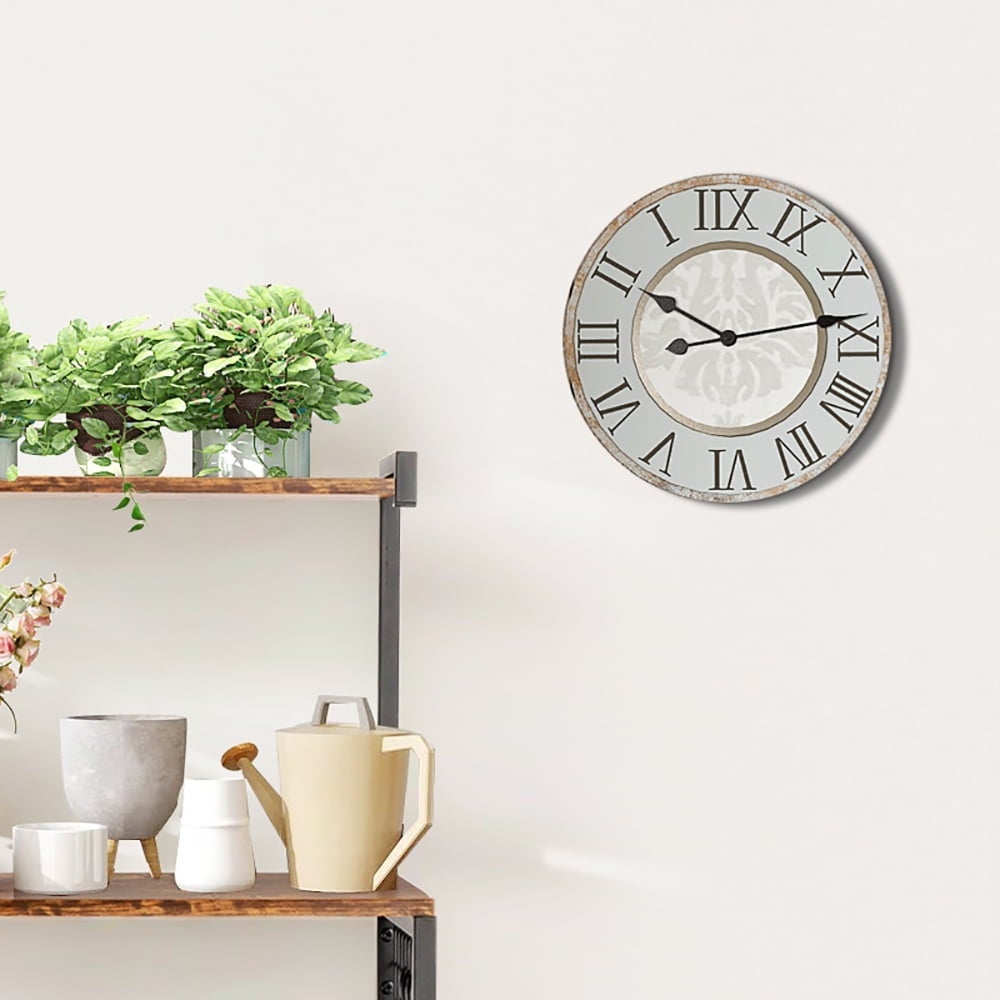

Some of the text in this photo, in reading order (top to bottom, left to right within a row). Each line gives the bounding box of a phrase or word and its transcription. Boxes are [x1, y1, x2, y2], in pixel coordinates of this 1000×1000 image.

[646, 203, 680, 247] I
[590, 250, 642, 298] II
[577, 318, 620, 364] III
